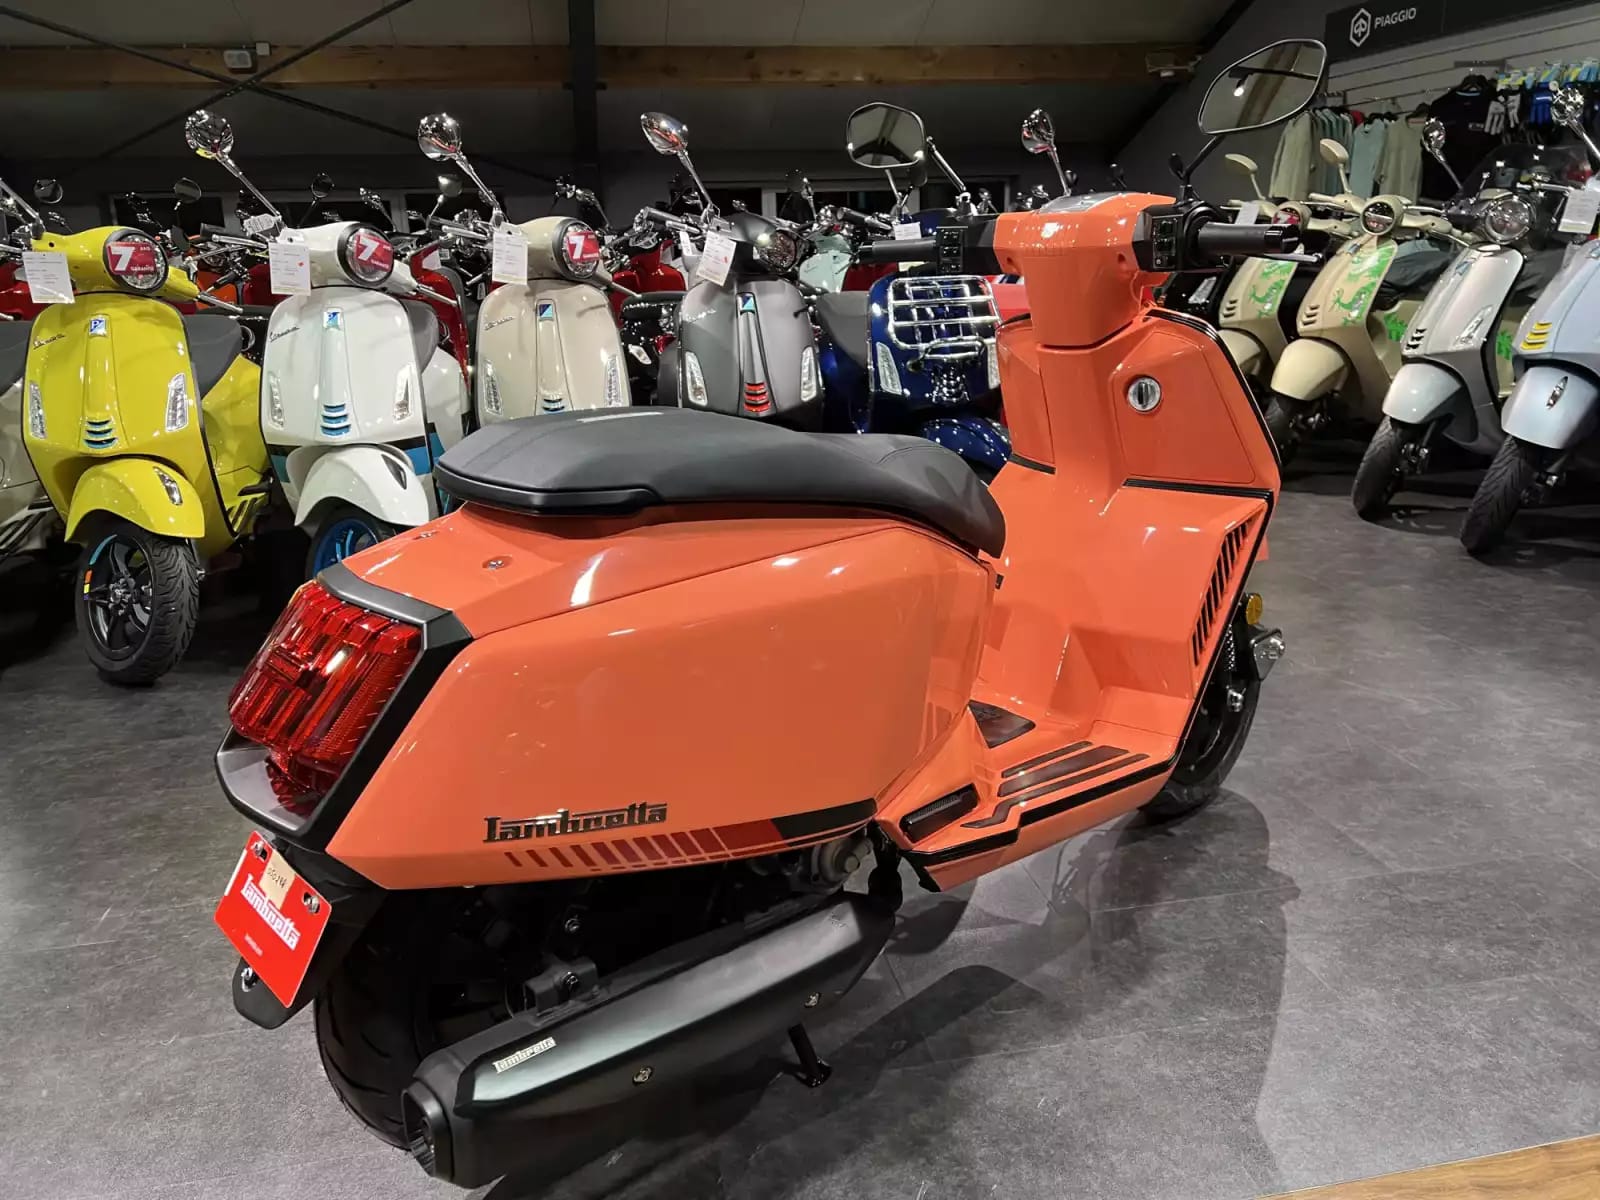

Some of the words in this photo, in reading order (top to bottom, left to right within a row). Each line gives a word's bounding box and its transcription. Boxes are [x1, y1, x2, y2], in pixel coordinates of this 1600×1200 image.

[1374, 7, 1417, 29] PIAGGIO
[110, 246, 136, 272] 7
[357, 236, 380, 261] 7
[568, 235, 585, 260] 7
[483, 801, 668, 843] Lambretta
[240, 873, 301, 951] Lambretta
[491, 1036, 557, 1074] Lambretta
